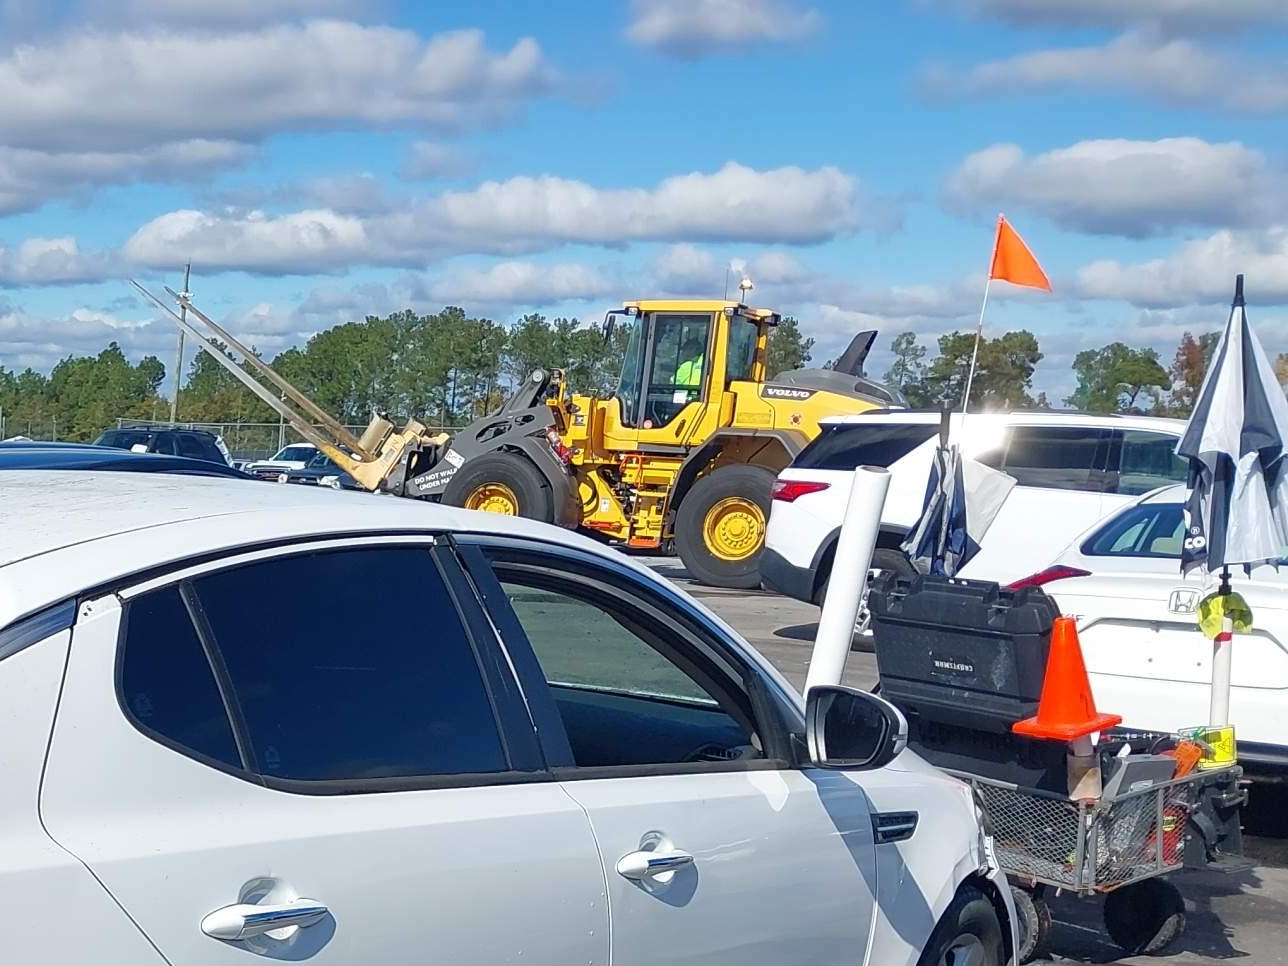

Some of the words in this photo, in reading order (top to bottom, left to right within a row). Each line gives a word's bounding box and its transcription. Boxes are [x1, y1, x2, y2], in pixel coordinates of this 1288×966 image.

[767, 389, 810, 398] VOLVO
[415, 477, 425, 485] DO
[425, 472, 439, 481] NOT
